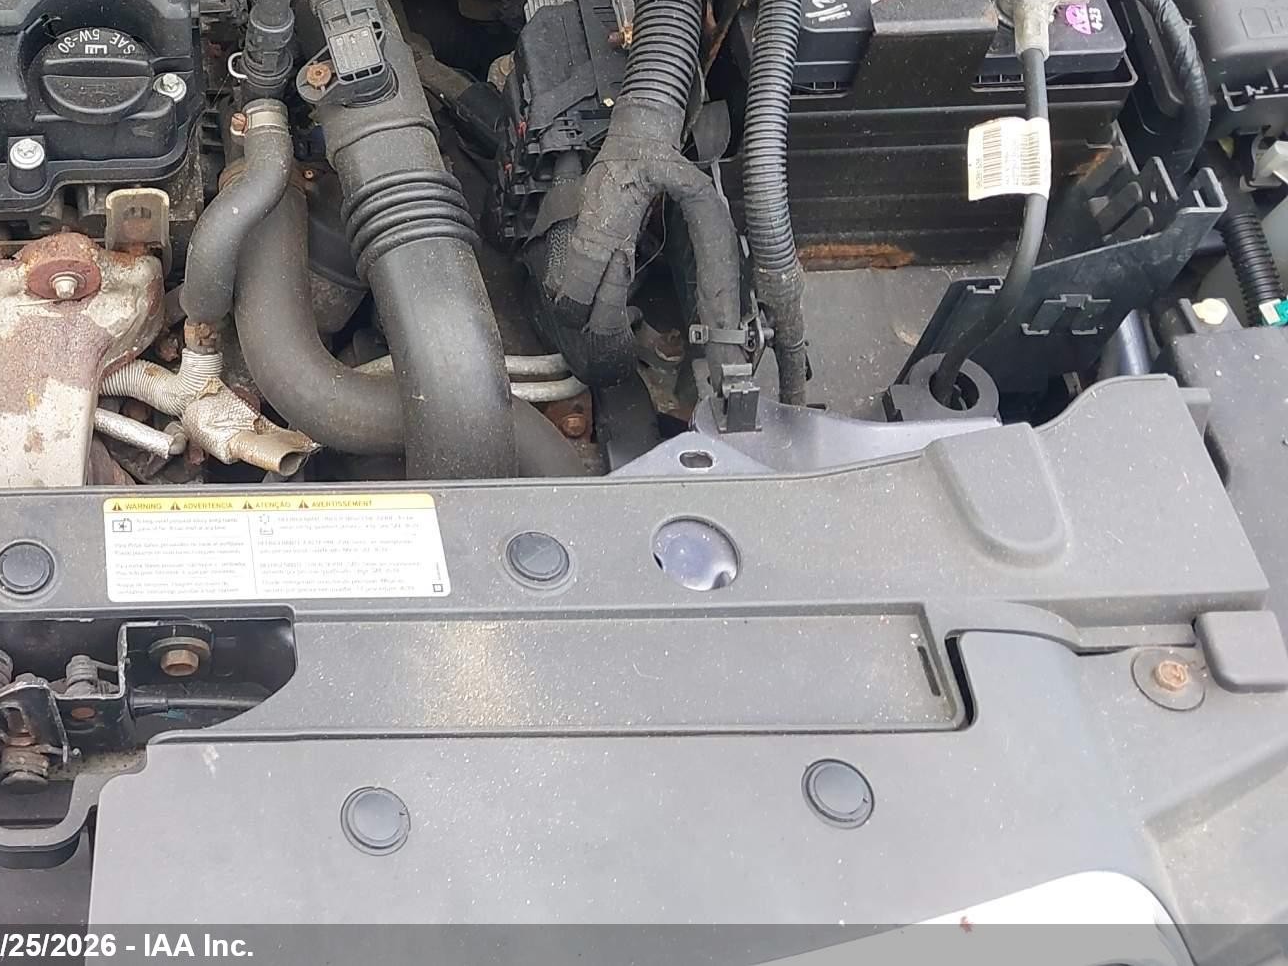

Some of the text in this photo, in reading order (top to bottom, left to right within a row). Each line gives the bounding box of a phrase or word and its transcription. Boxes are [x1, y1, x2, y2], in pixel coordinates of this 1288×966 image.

[57, 28, 136, 55] SAE 5W-30
[125, 503, 163, 511] WARNING
[183, 501, 234, 510] ADVERTENCIA
[311, 499, 373, 508] AVERTISSEMENT
